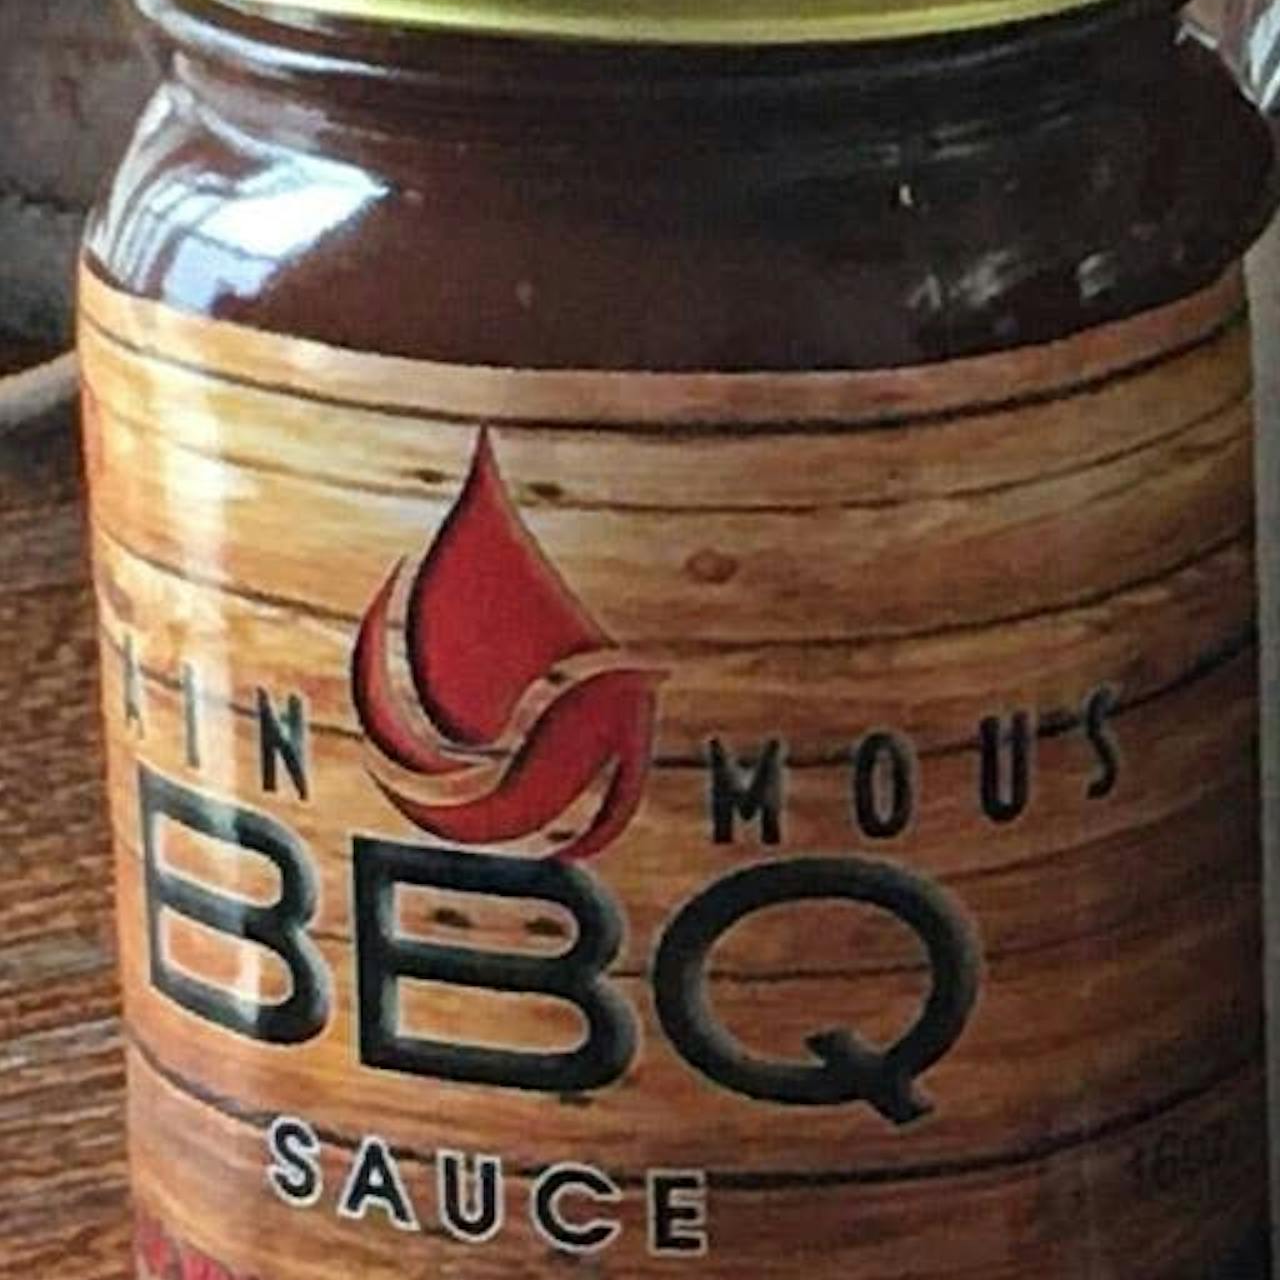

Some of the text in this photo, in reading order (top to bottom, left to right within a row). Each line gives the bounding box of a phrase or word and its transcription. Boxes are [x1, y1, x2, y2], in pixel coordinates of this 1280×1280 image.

[705, 688, 1122, 846] MOUS
[138, 766, 984, 1125] BBQ
[264, 1116, 711, 1254] SAUCE
